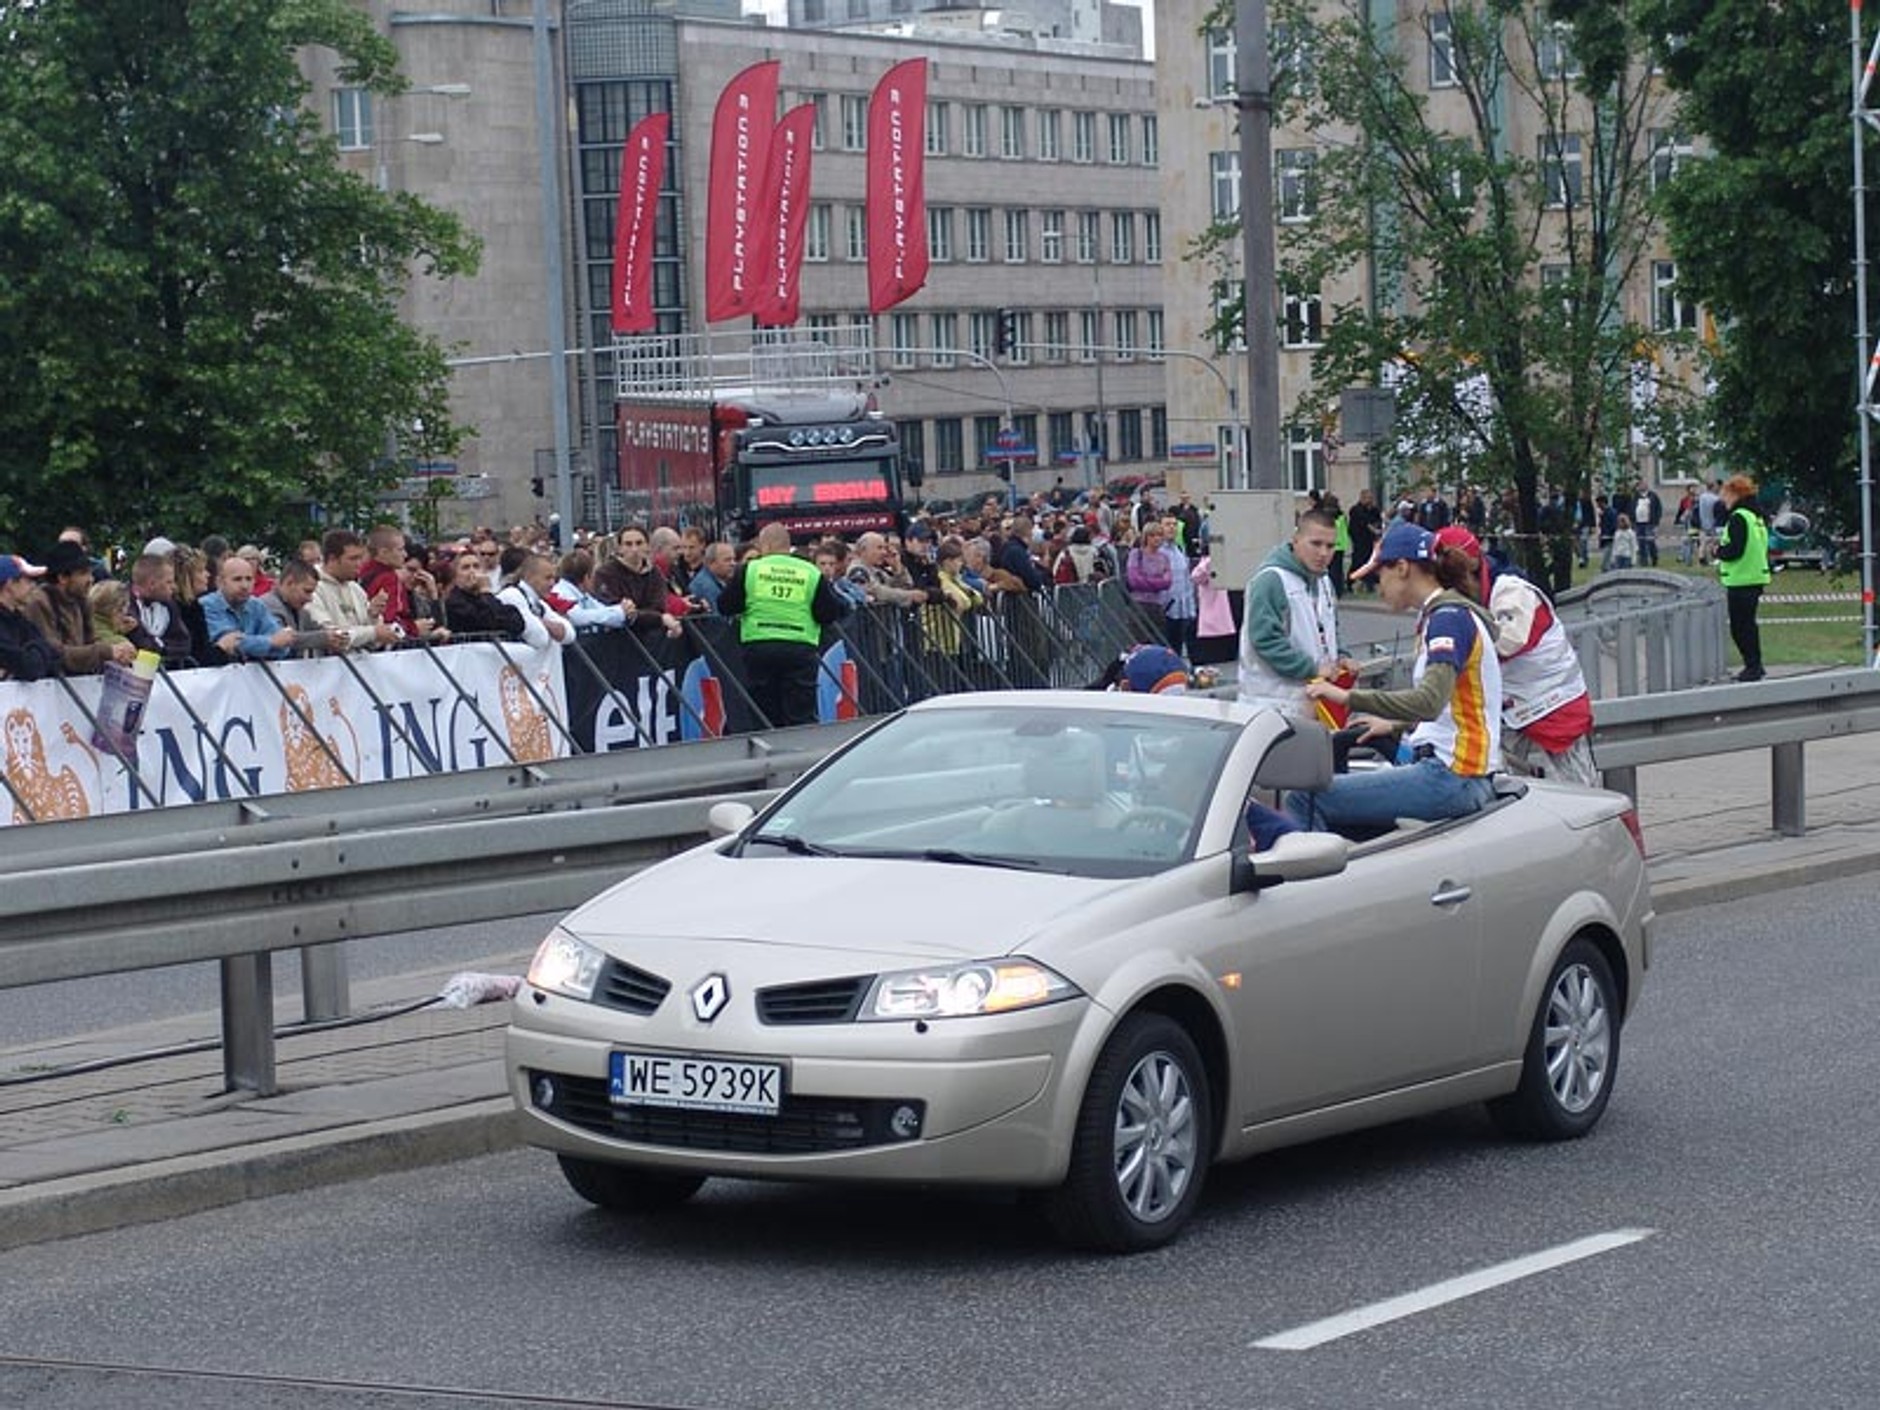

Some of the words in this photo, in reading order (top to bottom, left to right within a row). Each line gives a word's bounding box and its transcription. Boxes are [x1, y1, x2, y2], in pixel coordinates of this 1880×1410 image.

[739, 94, 749, 109] 3
[890, 88, 900, 104] 3
[733, 116, 749, 291] PLAYSTATION
[778, 149, 794, 298] PLAYSTATION
[890, 110, 904, 279] PLAYSTATION
[783, 517, 876, 530] LAYSTATION
[373, 690, 487, 780] ING
[595, 669, 677, 753] elf
[629, 1059, 672, 1094] WE
[682, 1064, 777, 1103] 5939K
